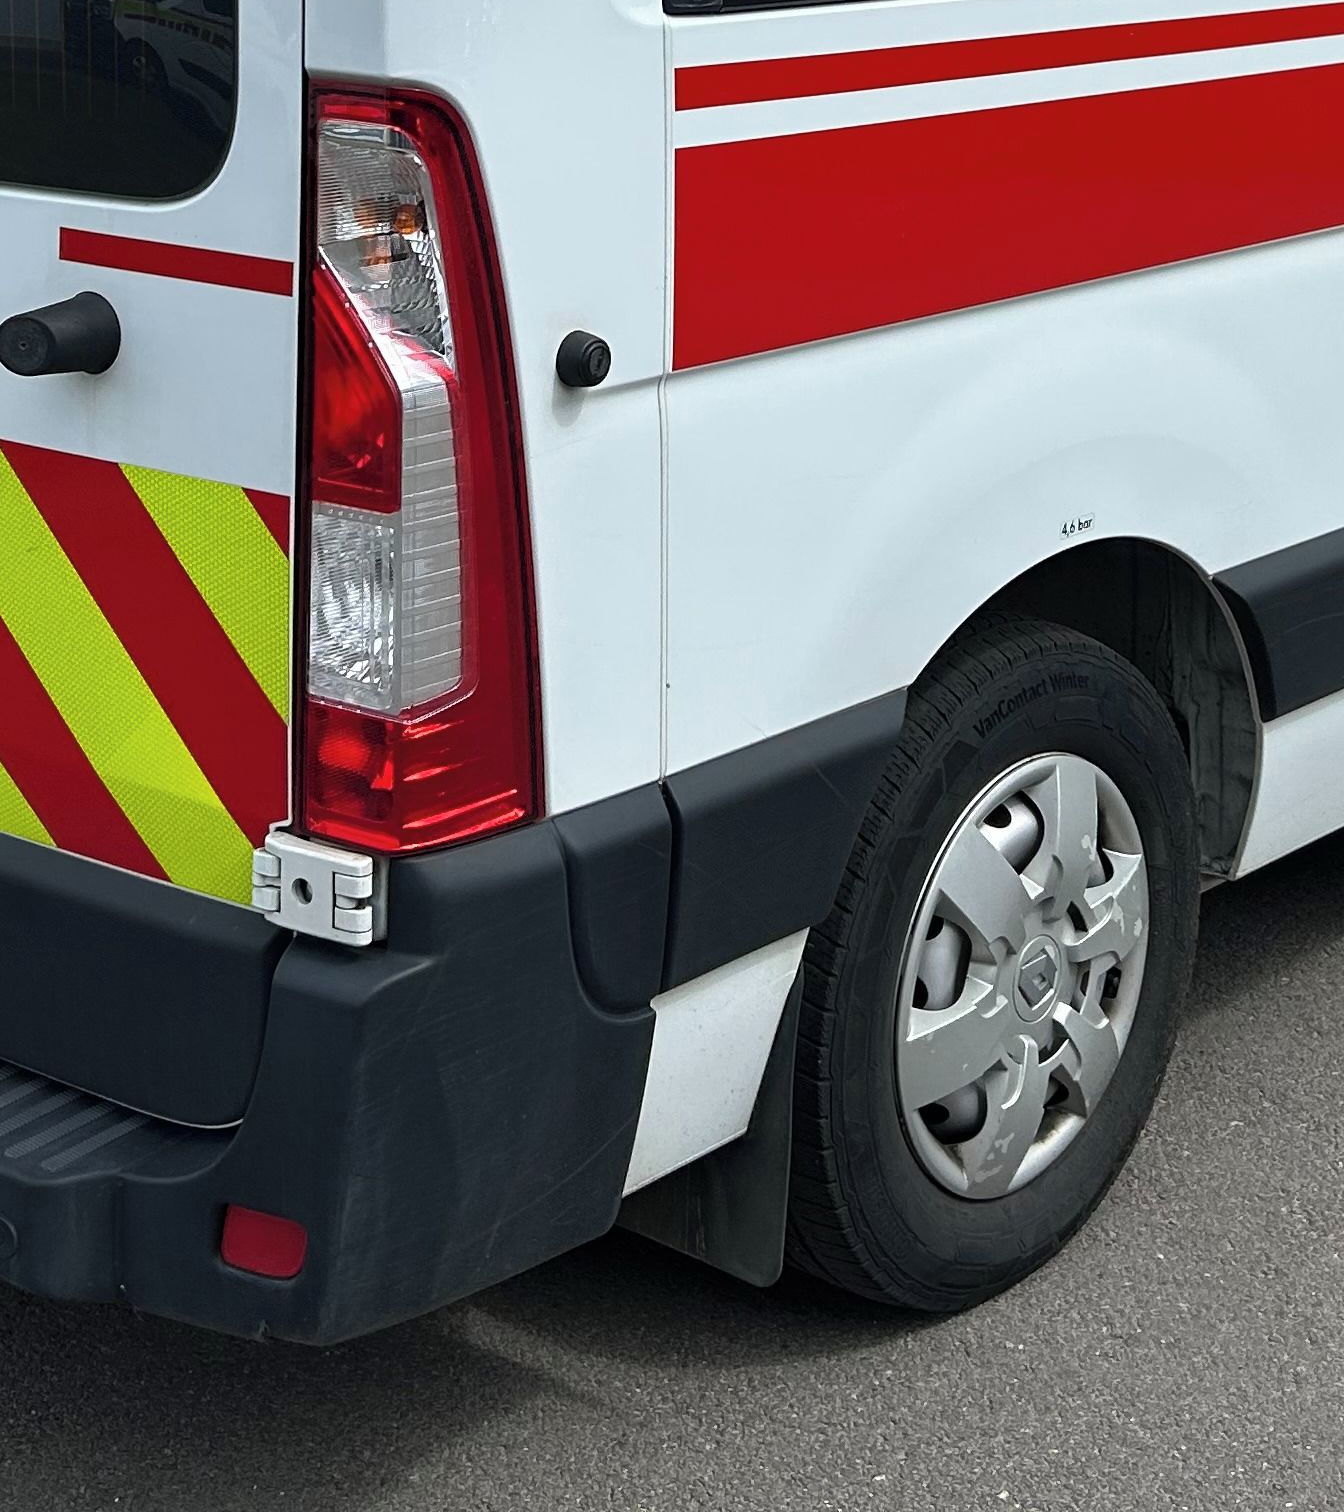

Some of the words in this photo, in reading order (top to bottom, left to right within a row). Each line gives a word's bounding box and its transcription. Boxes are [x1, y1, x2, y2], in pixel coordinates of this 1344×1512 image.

[1078, 518, 1093, 531] bar
[973, 678, 1049, 739] VanContact
[1048, 671, 1090, 693] Winter
